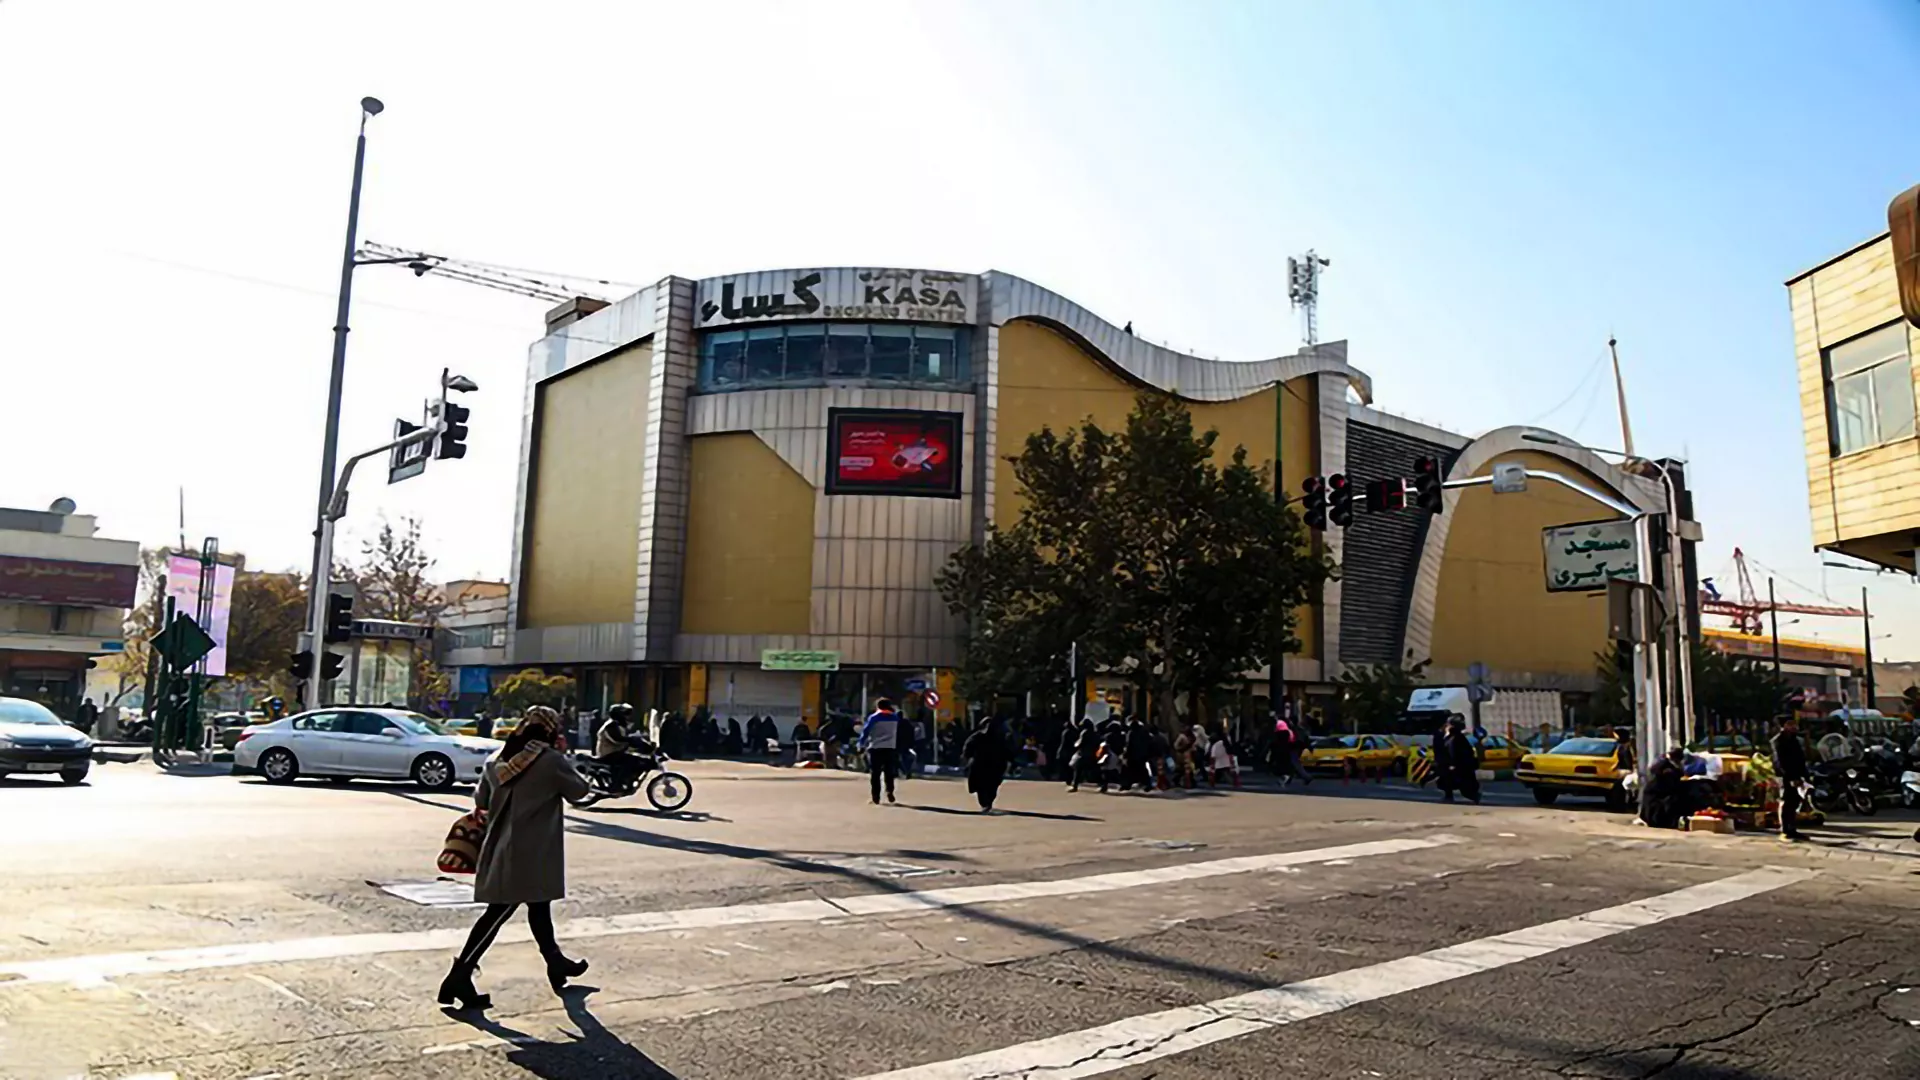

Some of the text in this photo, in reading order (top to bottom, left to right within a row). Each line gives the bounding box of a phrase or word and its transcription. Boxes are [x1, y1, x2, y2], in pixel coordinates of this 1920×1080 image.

[863, 284, 966, 309] KASA
[1564, 538, 1631, 559] مسجد
[1555, 561, 1607, 585] کبری
